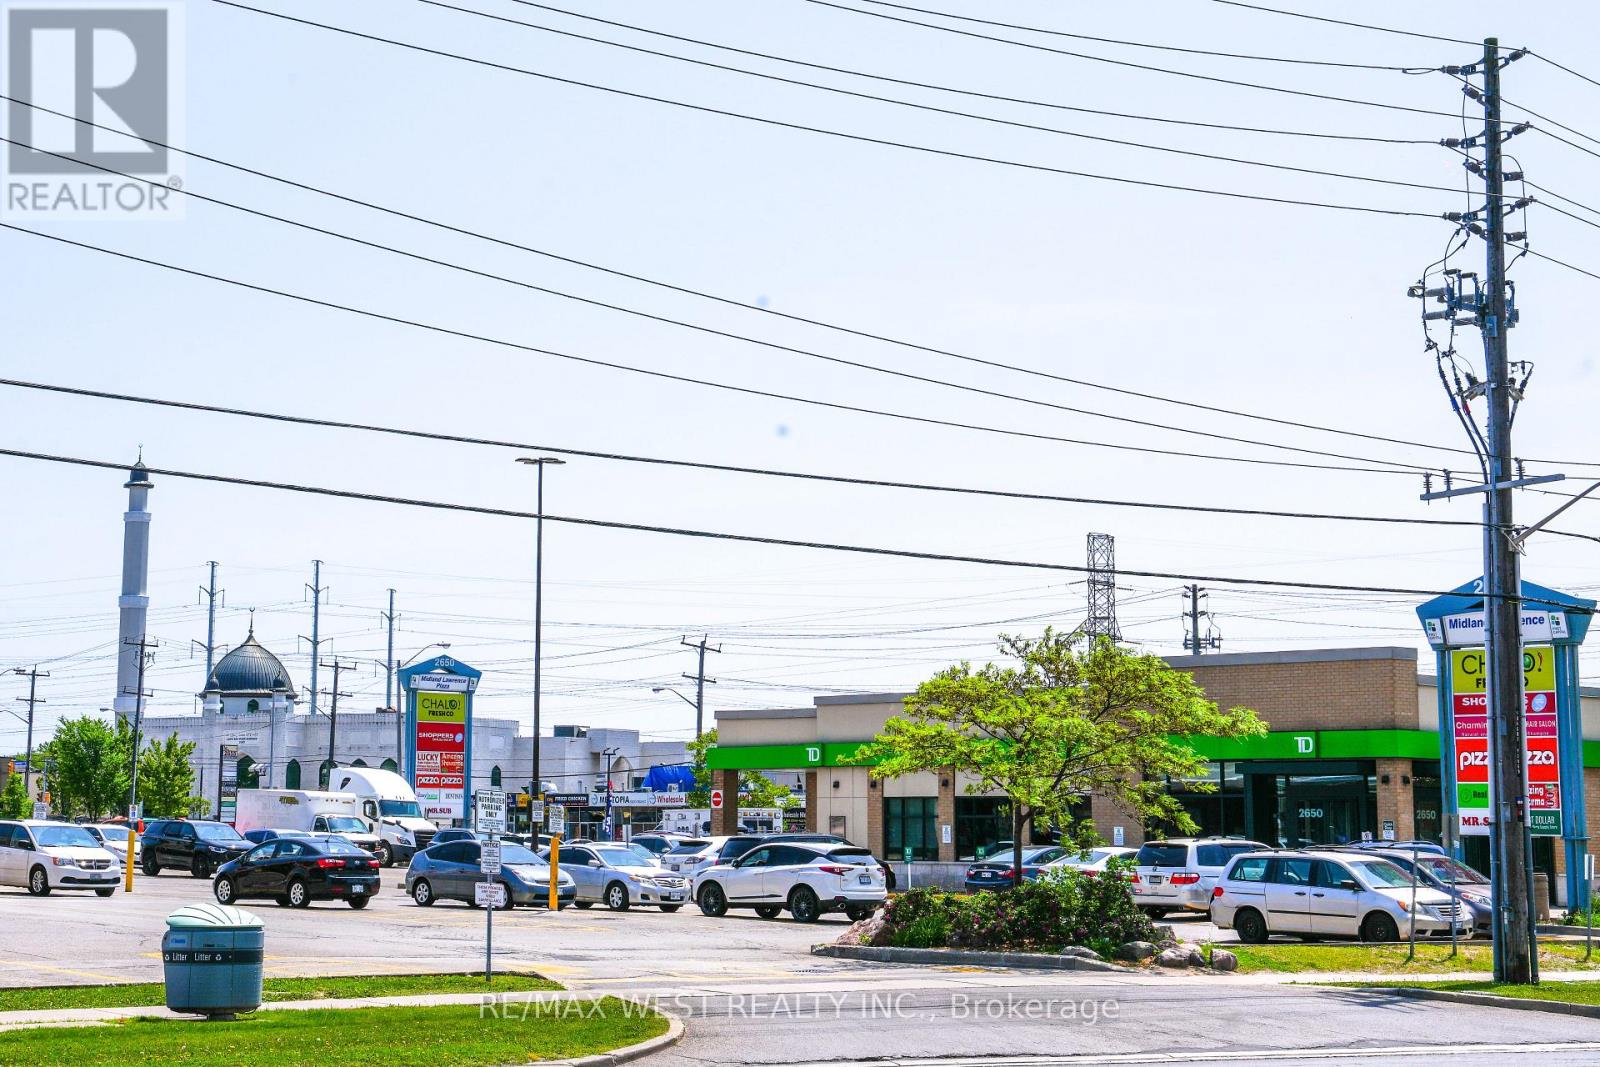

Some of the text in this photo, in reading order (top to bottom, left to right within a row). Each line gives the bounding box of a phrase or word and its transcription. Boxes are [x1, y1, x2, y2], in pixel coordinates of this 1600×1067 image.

[1448, 615, 1545, 629] Midlan ence
[434, 658, 455, 667] 2650
[1538, 720, 1556, 728] SALON
[1294, 736, 1313, 753] TD
[417, 753, 439, 761] LUCKY
[805, 747, 820, 762] TD
[417, 777, 463, 786] pizza pizza
[656, 795, 684, 803] Wholesale
[481, 803, 502, 811] PARKING
[485, 810, 498, 818] ONLY
[1298, 808, 1323, 818] 2650
[1416, 810, 1436, 819] 2650
[1535, 815, 1555, 825] DOLLAR
[172, 953, 211, 961] Litter Litter
